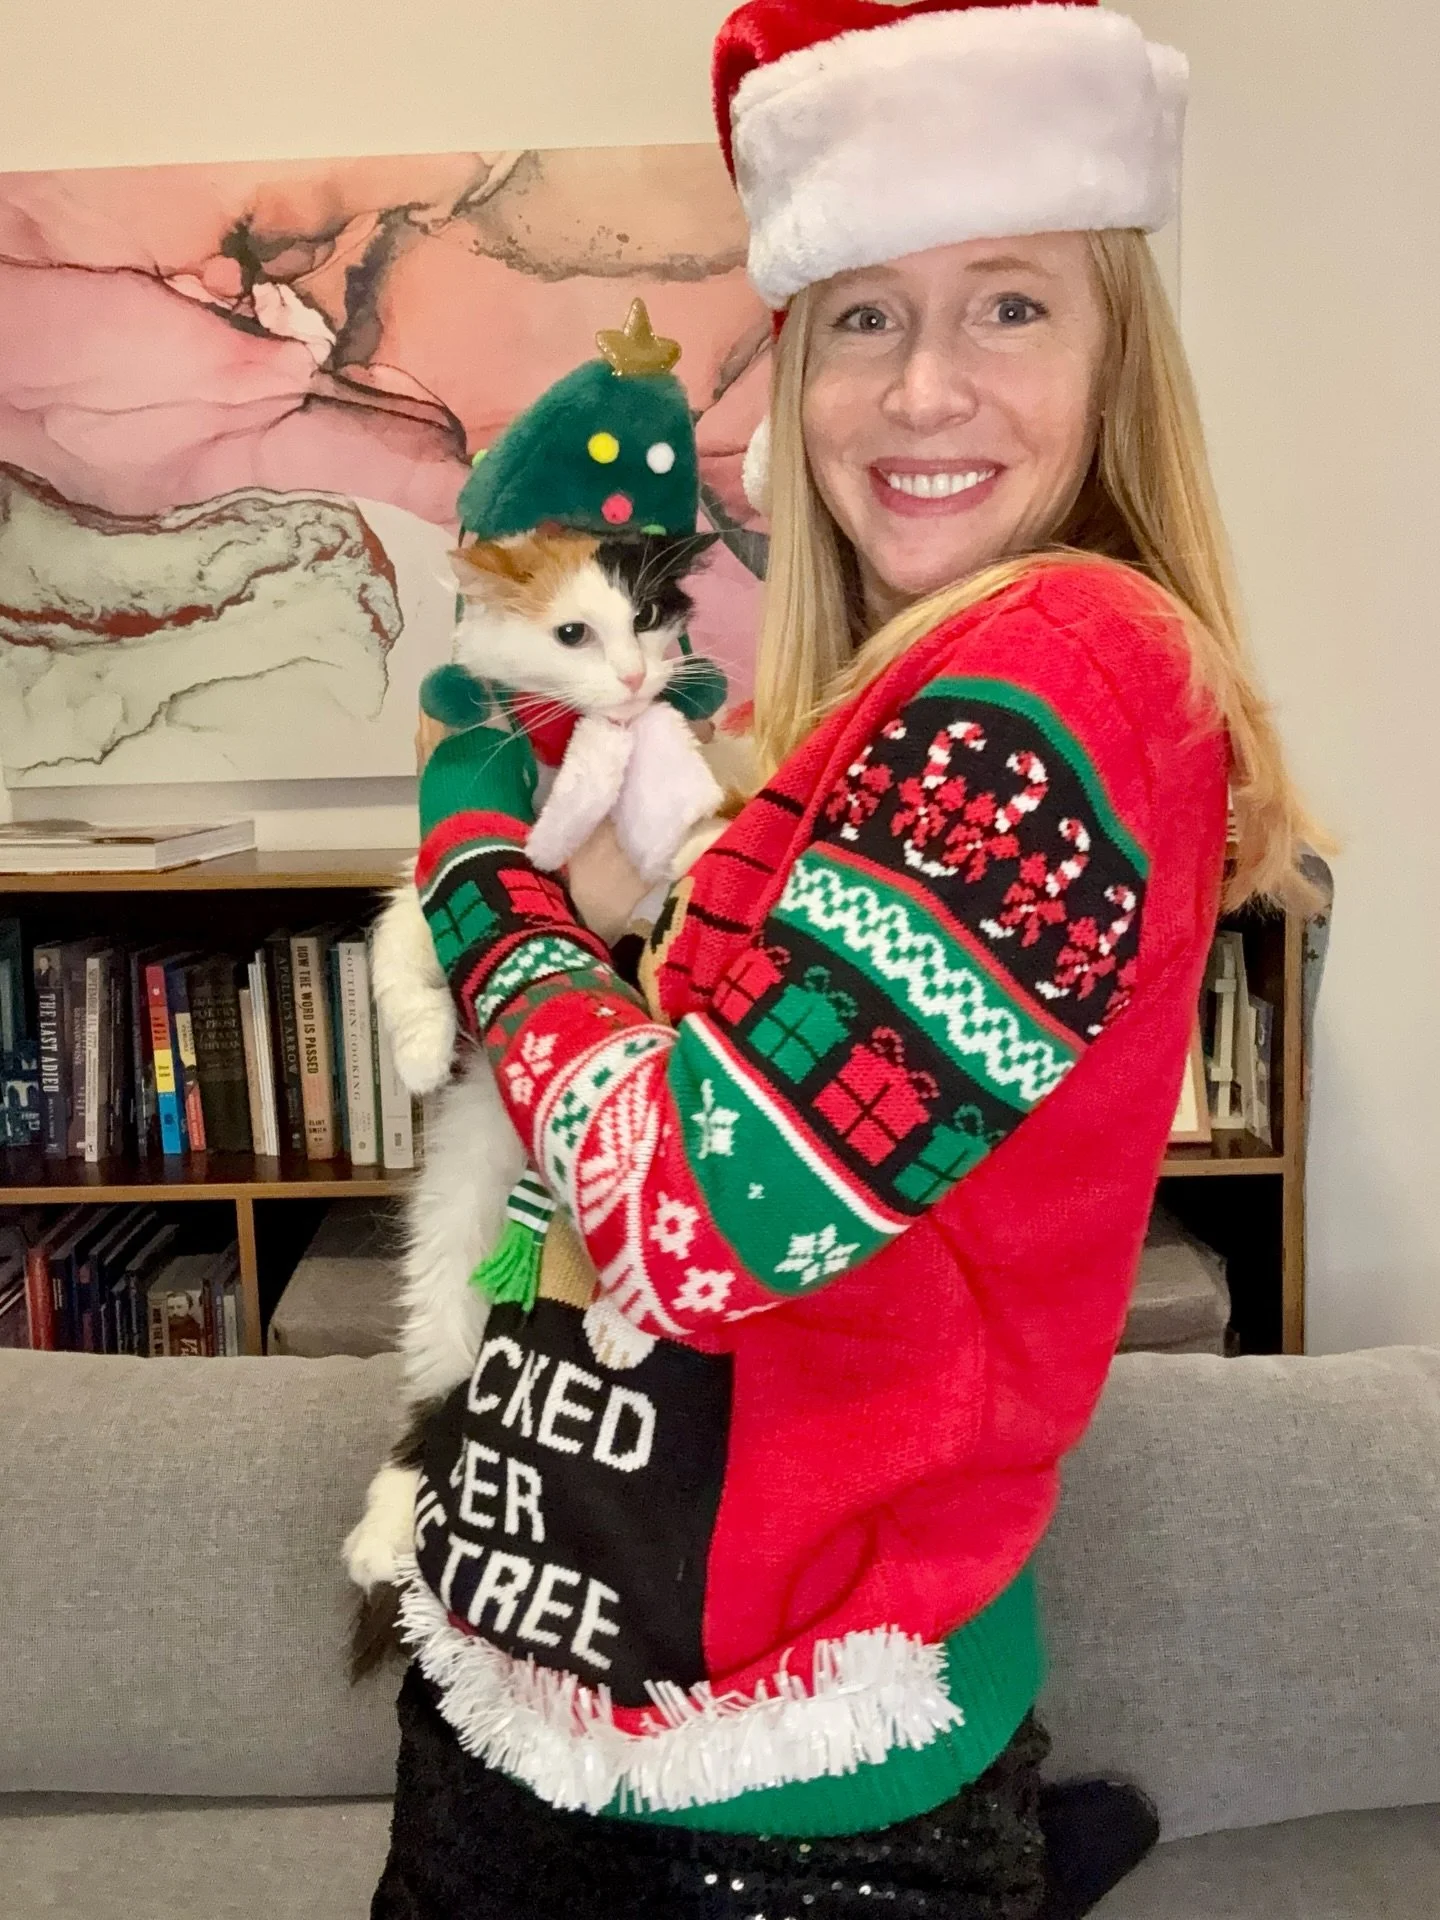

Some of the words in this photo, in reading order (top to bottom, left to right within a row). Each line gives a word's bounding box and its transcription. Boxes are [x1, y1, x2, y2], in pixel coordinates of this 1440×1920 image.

[296, 945, 309, 967] HOW
[87, 968, 98, 1015] SEPTEMBER
[299, 967, 311, 988] THE
[346, 947, 358, 1027] SOUTHERN
[39, 993, 57, 1017] THE
[301, 990, 315, 1021] WORD
[40, 1022, 58, 1052] LAST
[304, 1023, 315, 1034] IS
[285, 1023, 298, 1075] ARROW
[305, 1036, 319, 1074] PASSED
[351, 1033, 361, 1101] COOKING
[41, 1056, 59, 1093] ADIEU
[440, 1532, 620, 1670] TREE
